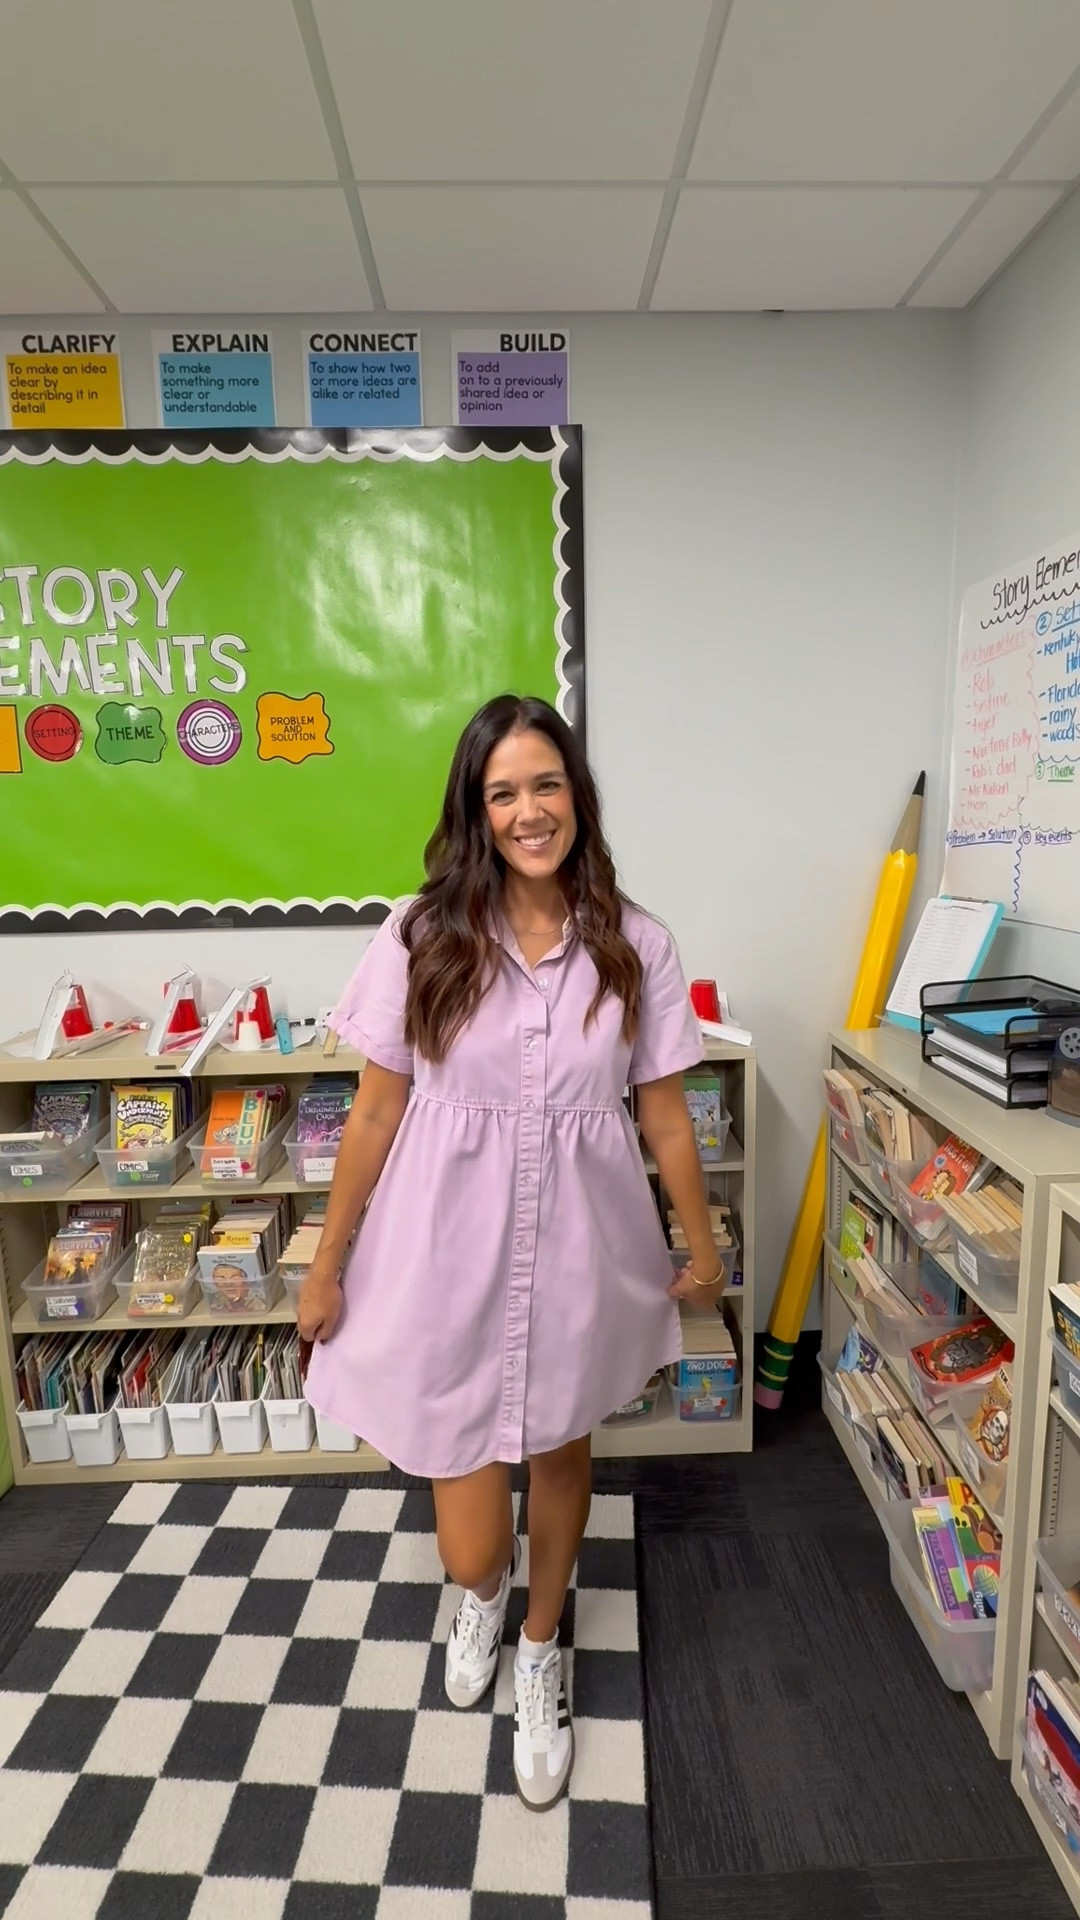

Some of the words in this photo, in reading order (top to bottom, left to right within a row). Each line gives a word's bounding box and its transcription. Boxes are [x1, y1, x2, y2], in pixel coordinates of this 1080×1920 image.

[21, 334, 116, 354] CLARIFY
[172, 333, 269, 353] EXPLAIN
[309, 333, 418, 353] CONNECT
[500, 333, 566, 353] BUILD
[8, 362, 22, 375] To
[26, 363, 59, 375] make
[62, 365, 78, 375] an
[80, 362, 107, 375] idea
[161, 362, 175, 374] To
[178, 362, 211, 374] make
[311, 362, 325, 374] To
[328, 362, 358, 374] show
[362, 362, 387, 374] how
[390, 363, 411, 373] two
[459, 361, 473, 373] To
[476, 361, 500, 373] add
[9, 376, 40, 388] clear
[44, 376, 58, 391] by
[162, 375, 224, 390] something
[228, 377, 259, 387] more
[311, 377, 325, 386] or
[328, 377, 359, 387] more
[362, 375, 394, 386] ideas
[397, 377, 417, 386] are
[459, 376, 475, 386] on
[478, 375, 491, 386] to
[495, 376, 502, 386] a
[505, 374, 564, 389] previously
[11, 389, 73, 404] describing
[76, 389, 84, 400] it
[87, 389, 98, 400] in
[164, 389, 194, 400] clear
[198, 391, 211, 400] or
[312, 388, 339, 399] alike
[342, 390, 355, 399] or
[358, 388, 400, 399] related
[460, 387, 500, 398] shared
[503, 387, 529, 399] idea
[532, 389, 545, 398] or
[12, 401, 46, 414] detail
[164, 401, 258, 413] understandable
[460, 400, 503, 414] opinion
[0, 565, 185, 630] TORY
[993, 575, 1030, 625] Story
[270, 716, 315, 726] PROBLEM
[1049, 705, 1076, 728] rainy
[33, 726, 76, 739] SETTING
[106, 725, 155, 741] THEME
[178, 721, 240, 740] CHARACTERS
[284, 725, 302, 733] AND
[271, 732, 316, 742] SOLUTION
[1048, 765, 1074, 778] Theme
[988, 826, 1017, 841] Solution
[1048, 831, 1072, 842] events
[117, 1099, 167, 1111] CAPTAIN
[13, 1166, 38, 1175] COMICS
[119, 1162, 144, 1171] COMICS
[687, 1360, 704, 1371] TWO
[706, 1359, 732, 1370] DOGS
[938, 1564, 956, 1608] WORD
